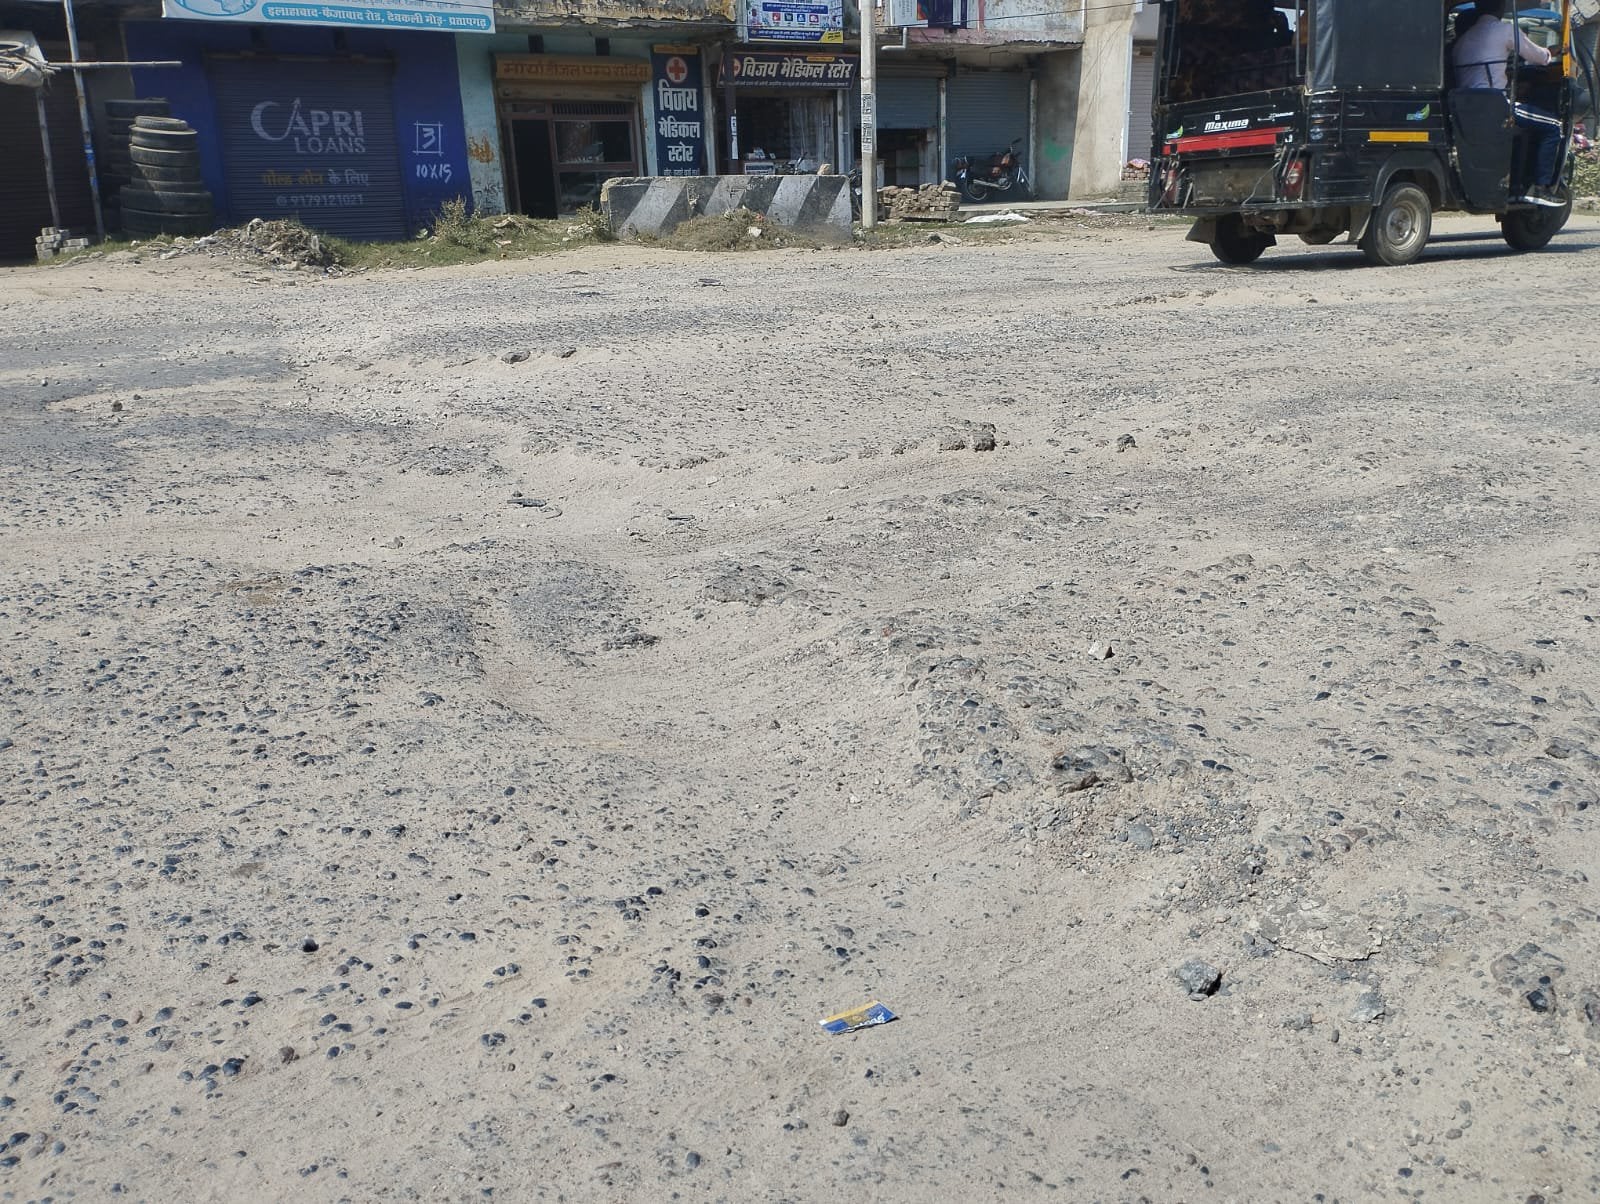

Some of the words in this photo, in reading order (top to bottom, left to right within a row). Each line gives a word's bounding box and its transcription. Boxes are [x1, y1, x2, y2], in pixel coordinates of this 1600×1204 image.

[742, 56, 779, 78] विजय
[780, 57, 825, 79] मेडिकल
[827, 58, 854, 79] स्टोर
[657, 78, 698, 112] विजय
[250, 97, 365, 141] CAPRI
[657, 115, 701, 139] मेडिकल
[294, 137, 366, 153] LOANS
[667, 140, 694, 162] स्टोर
[327, 168, 342, 185] के
[344, 168, 370, 186] लिए
